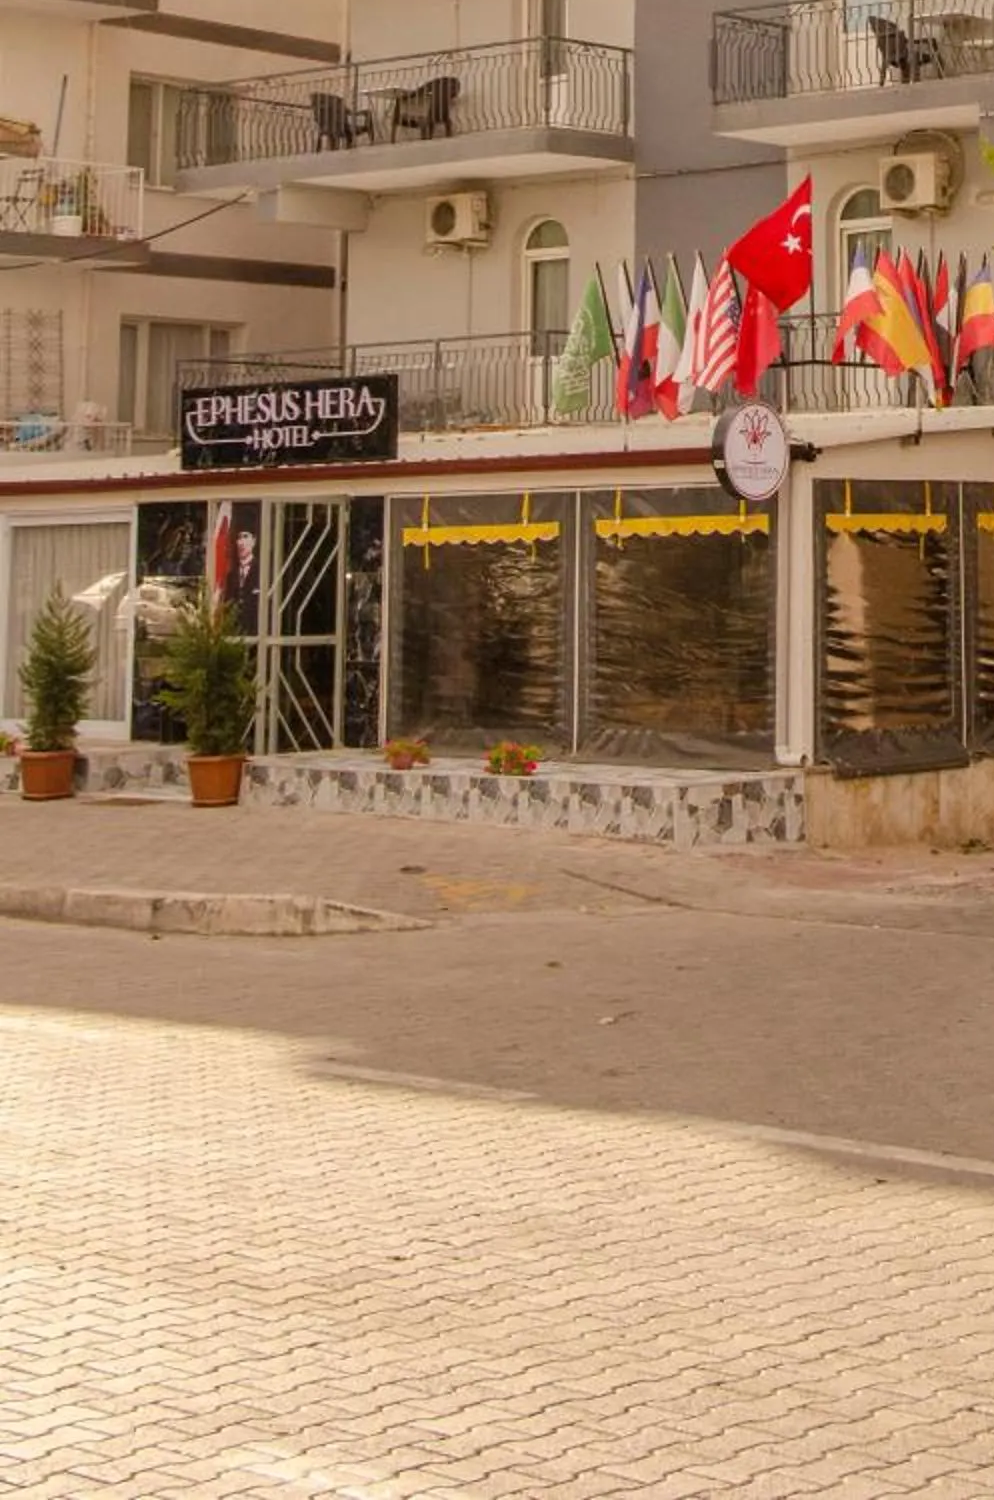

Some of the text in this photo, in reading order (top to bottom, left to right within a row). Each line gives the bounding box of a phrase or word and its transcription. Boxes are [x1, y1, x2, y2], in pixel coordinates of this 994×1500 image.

[197, 386, 375, 426] EPHESUS HERA
[253, 425, 315, 449] HOTEL
